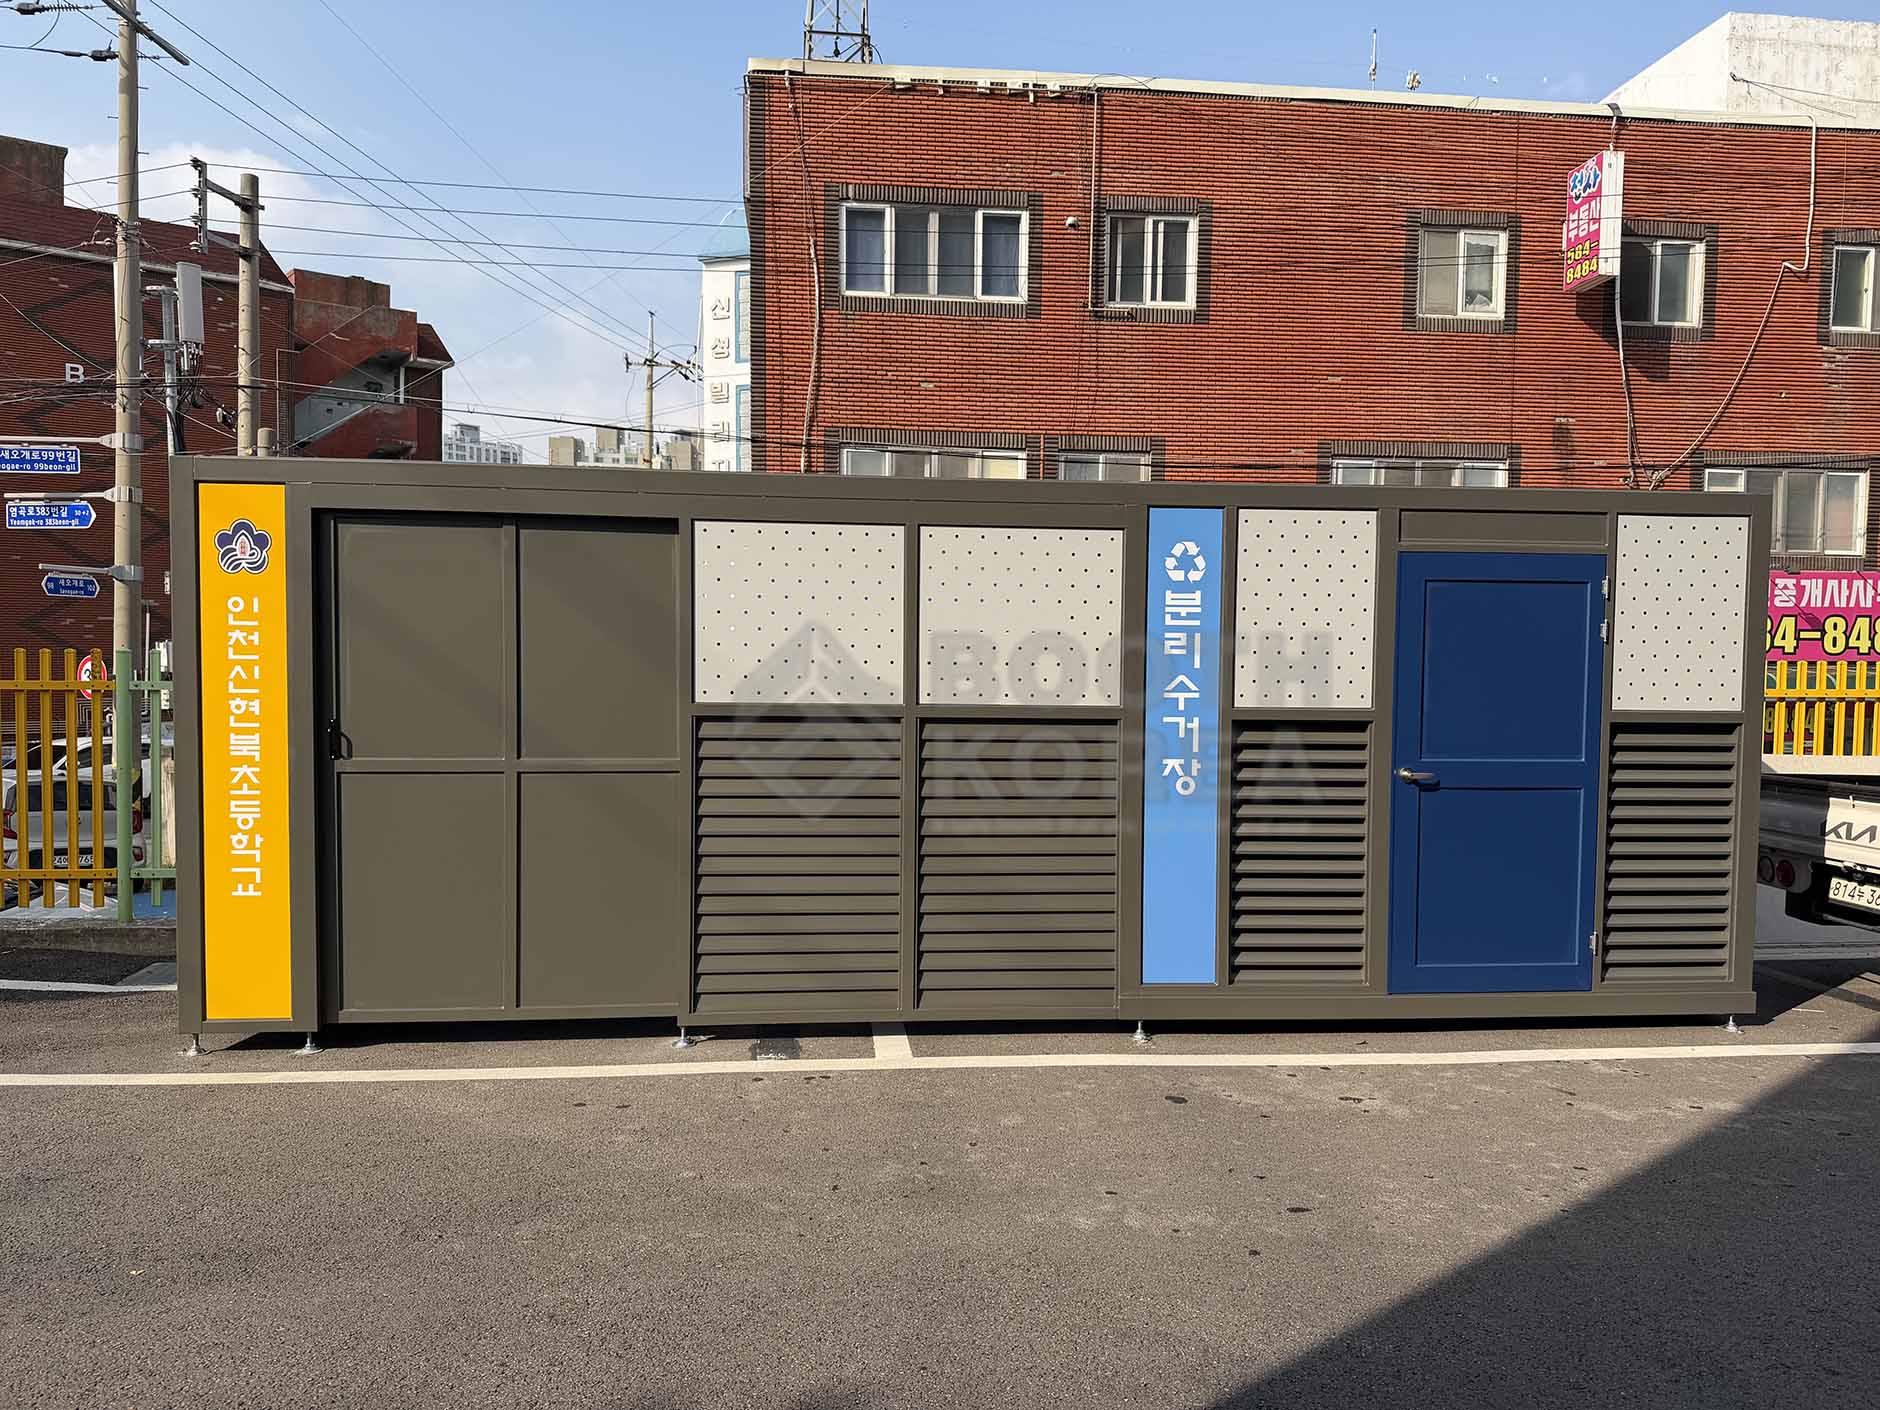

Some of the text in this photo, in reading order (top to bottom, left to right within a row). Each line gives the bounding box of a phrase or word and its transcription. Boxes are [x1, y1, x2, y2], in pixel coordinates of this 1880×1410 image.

[1568, 197, 1600, 242] 부동산
[1566, 258, 1599, 284] 8484
[65, 363, 85, 383] B
[1161, 589, 1203, 797] 분리수거장
[226, 595, 264, 898] 인천신현북초등학교
